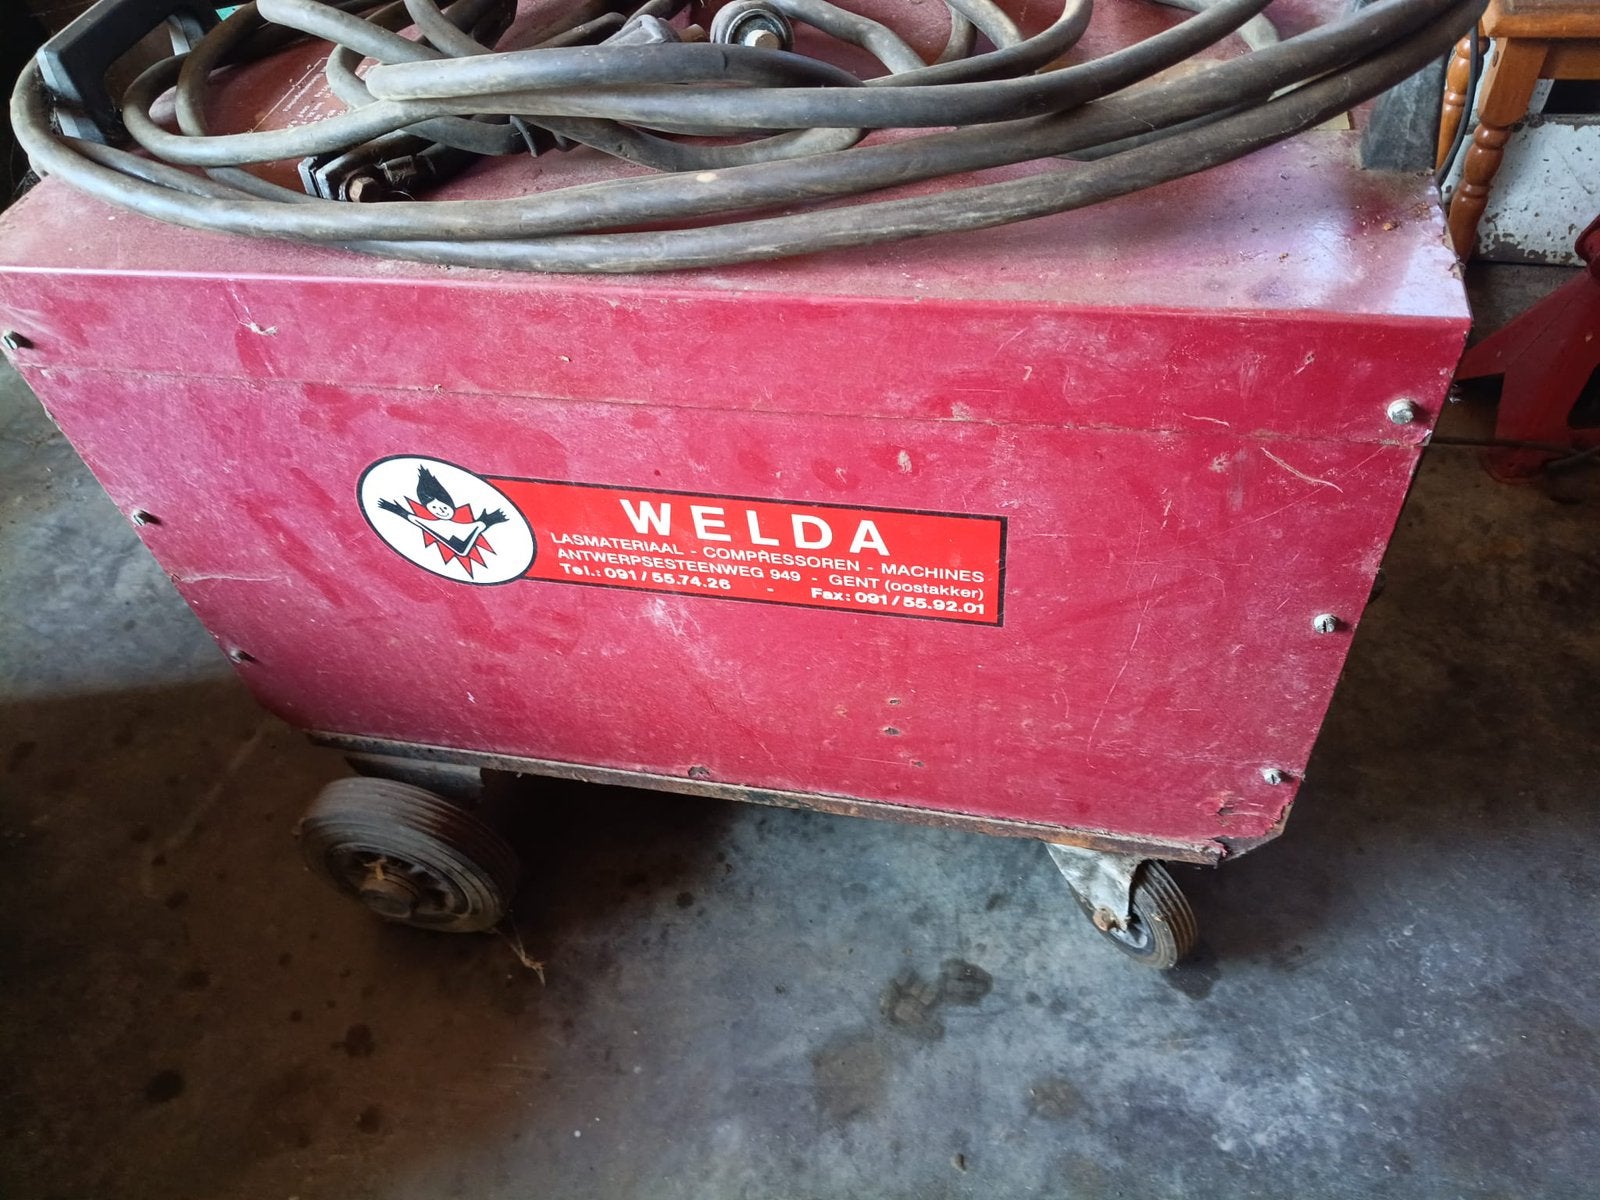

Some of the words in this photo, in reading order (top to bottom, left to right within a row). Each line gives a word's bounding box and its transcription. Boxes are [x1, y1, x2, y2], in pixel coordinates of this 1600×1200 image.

[619, 499, 890, 556] WELDA
[550, 532, 684, 555] LASMATERIAAL
[702, 546, 860, 572] COMPRESSOREN
[881, 563, 984, 583] MACHINES
[557, 548, 764, 578] ANTWERPSESTEENWEG
[769, 569, 801, 582] 949
[829, 574, 880, 589] GENT
[884, 580, 984, 601] (oostakker)
[559, 563, 601, 580] Tel.:
